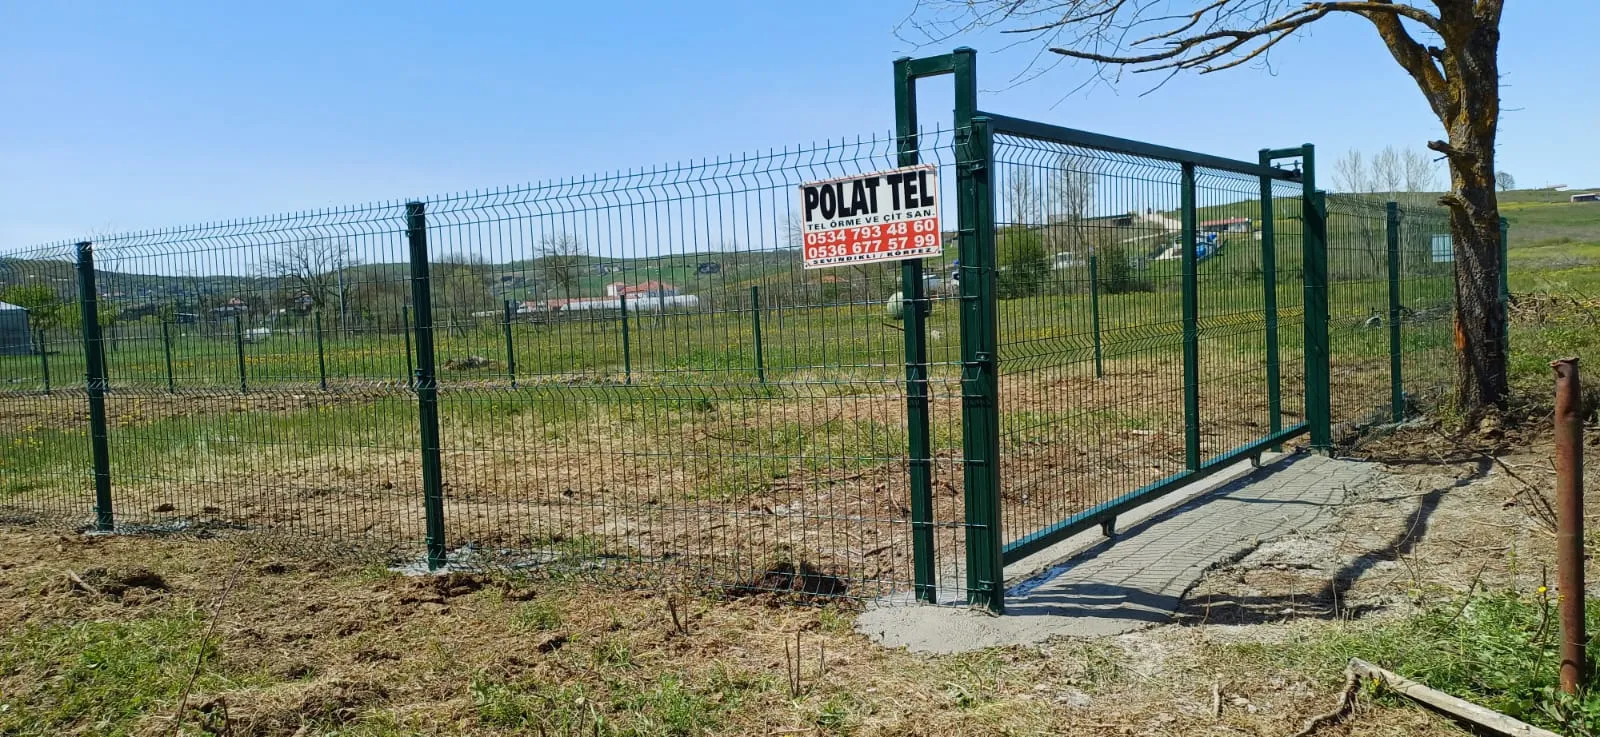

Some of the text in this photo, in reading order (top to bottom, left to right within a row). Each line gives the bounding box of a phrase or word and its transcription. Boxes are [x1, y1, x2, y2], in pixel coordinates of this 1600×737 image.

[804, 170, 934, 222] POLAT TEL
[830, 218, 861, 228] ÖRME
[907, 210, 935, 218] SAN.
[807, 219, 934, 245] 0534 793 48 60
[808, 234, 935, 259] 0536 677 57 99
